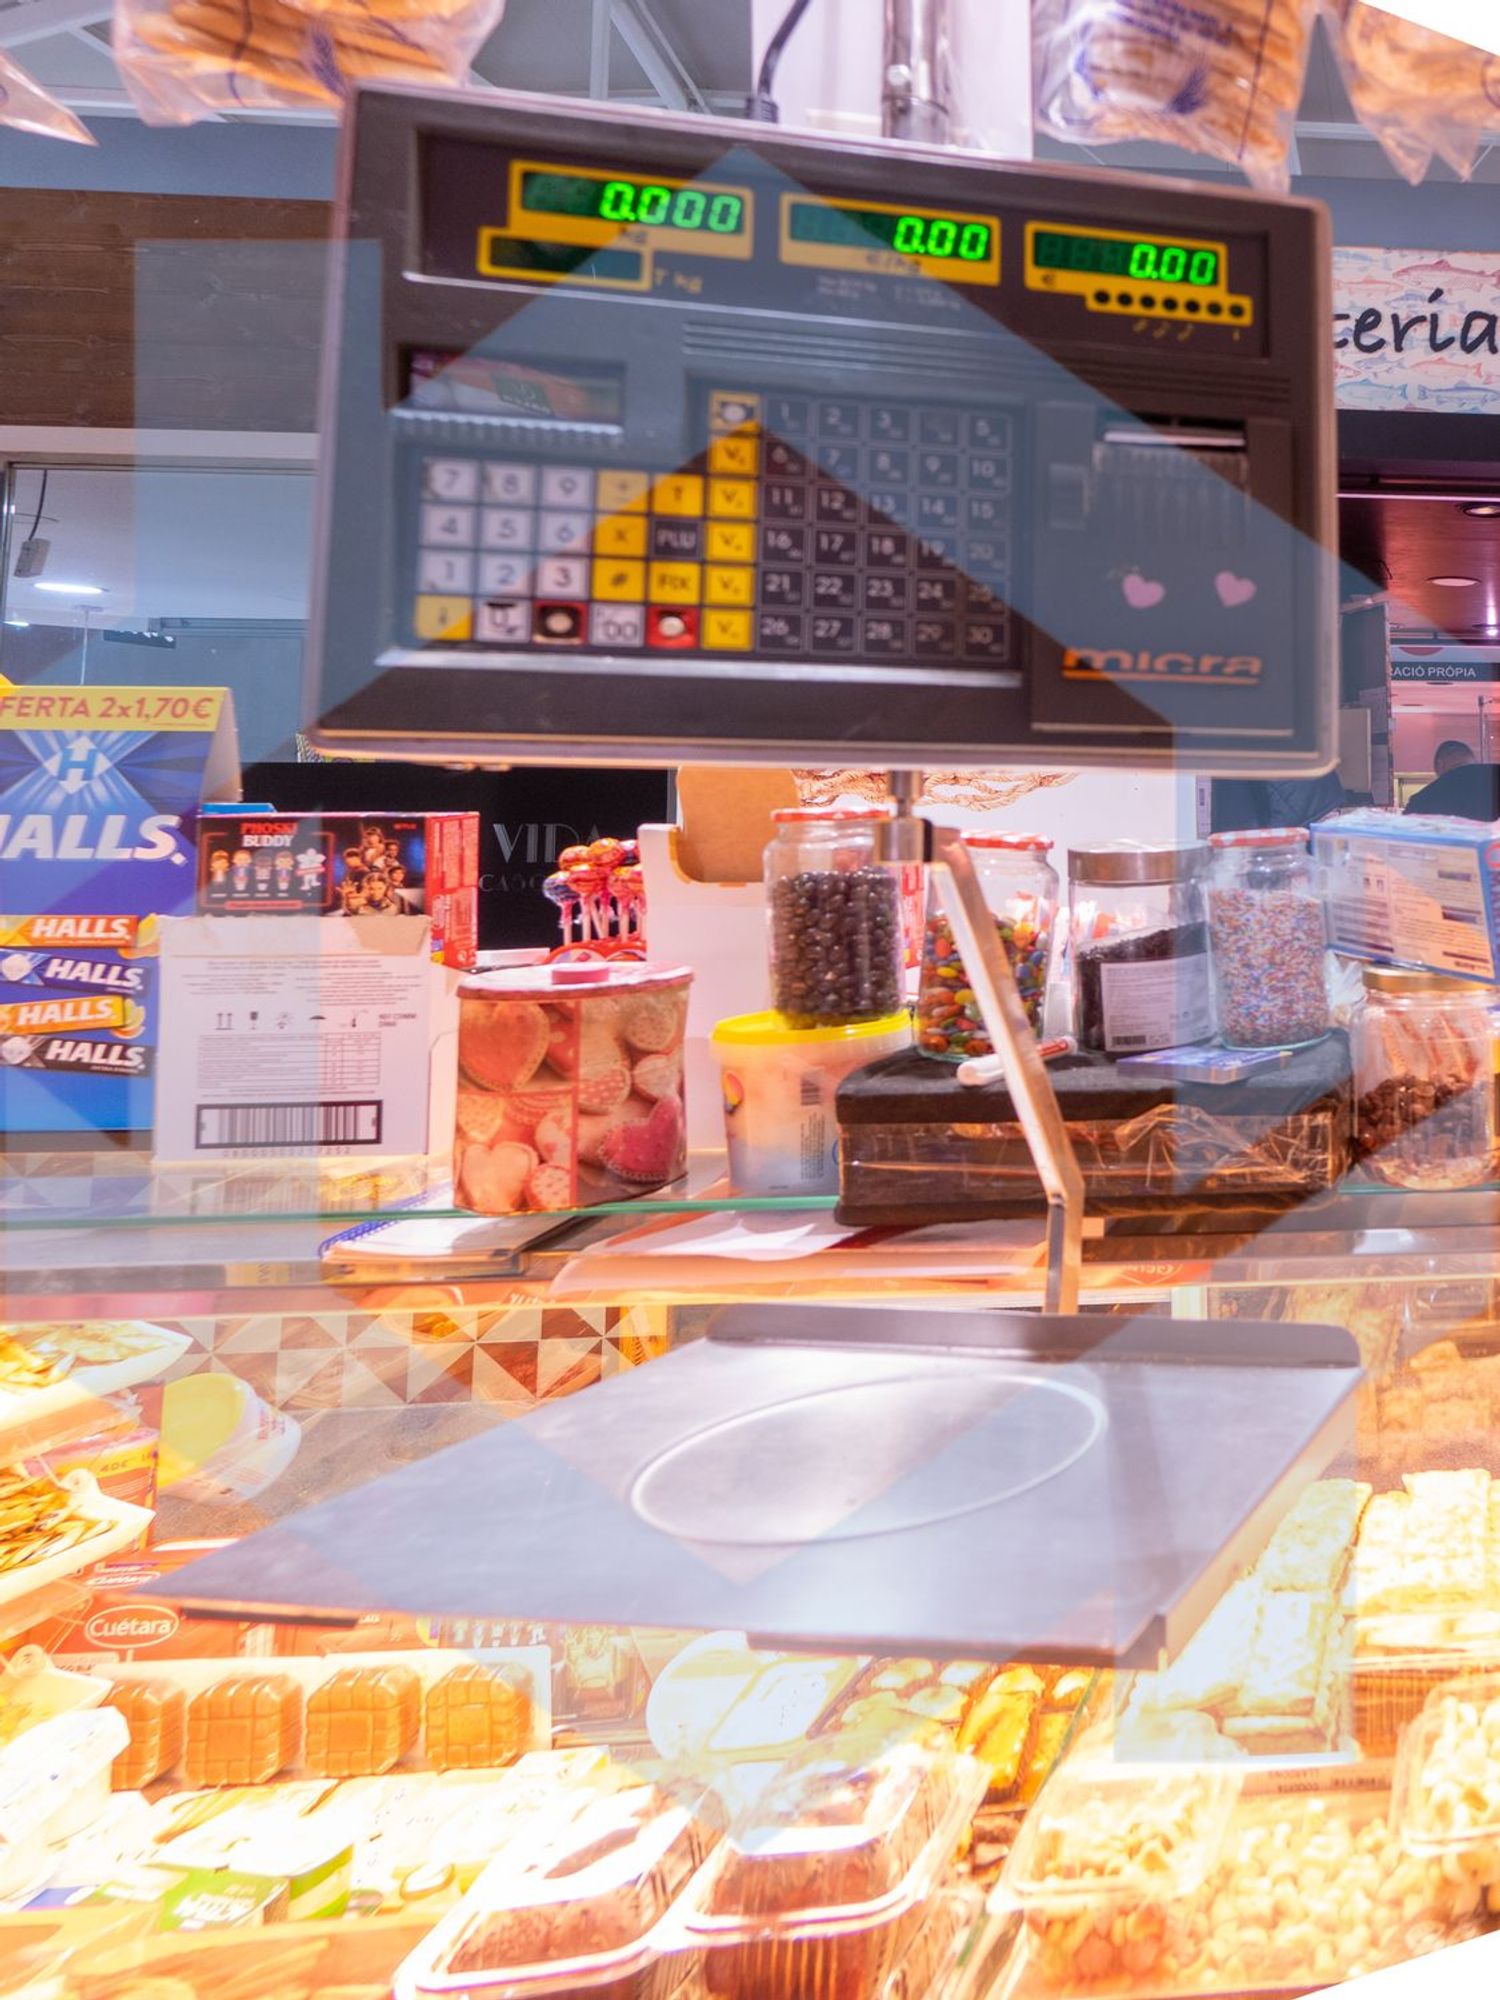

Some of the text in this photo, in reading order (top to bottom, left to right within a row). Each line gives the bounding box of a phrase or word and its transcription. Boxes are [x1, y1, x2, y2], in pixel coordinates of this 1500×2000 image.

[599, 181, 741, 232] 0.000
[893, 216, 989, 260] 0.00
[1129, 243, 1215, 285] 0.00
[657, 529, 696, 548] PLU
[497, 562, 515, 584] 2
[555, 566, 571, 587] 3
[1427, 664, 1477, 678] PRÒPIA
[0, 814, 188, 867] ALLS
[242, 834, 294, 848] BUDDY
[89, 1617, 172, 1637] Cuétara
